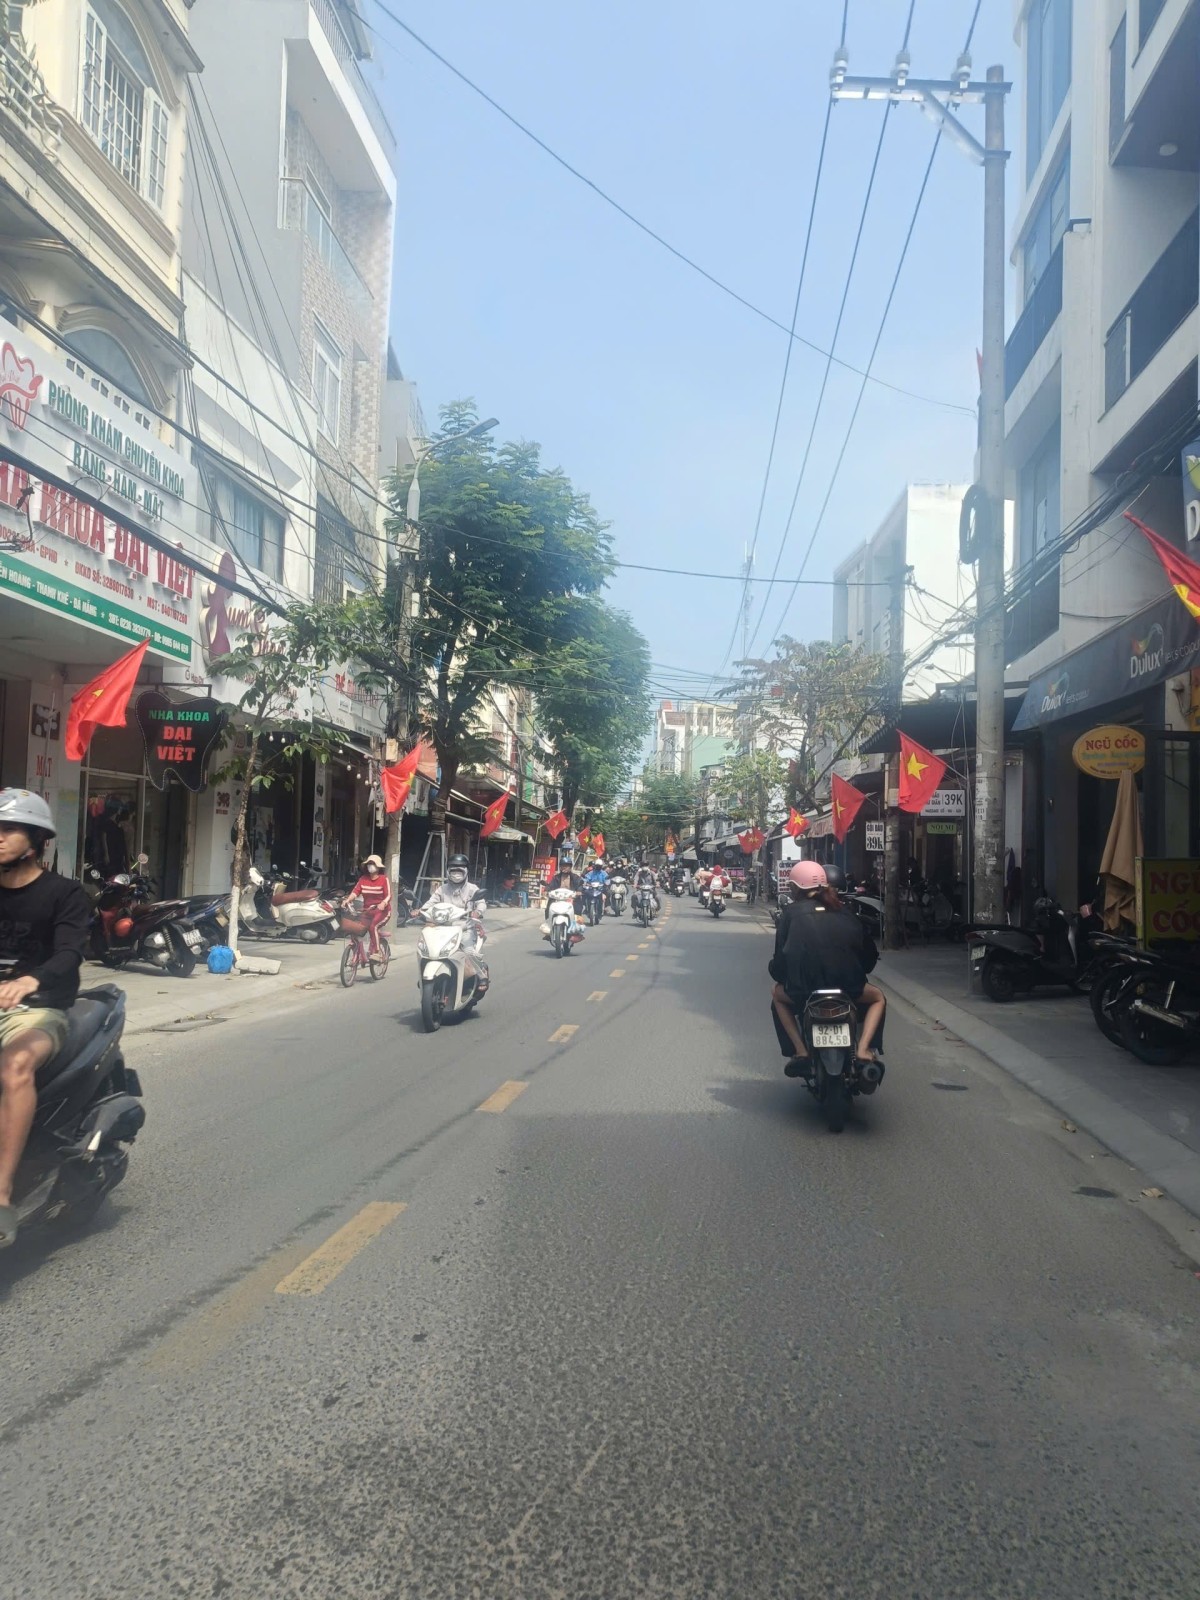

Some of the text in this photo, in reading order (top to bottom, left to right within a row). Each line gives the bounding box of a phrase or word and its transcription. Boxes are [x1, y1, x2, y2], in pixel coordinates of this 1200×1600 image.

[49, 380, 185, 500] PHÒNG KHÁM CHUYÊN KHOA
[114, 469, 137, 505] HÀM
[144, 489, 164, 523] MẶT
[157, 542, 195, 602] VIỆT
[1130, 650, 1161, 679] Dulux
[148, 709, 210, 722] NHA KHOA
[163, 726, 193, 743] ĐẠI
[1085, 733, 1138, 751] NGŨ CỐC
[157, 743, 196, 764] VIỆT
[944, 793, 963, 806] 39K
